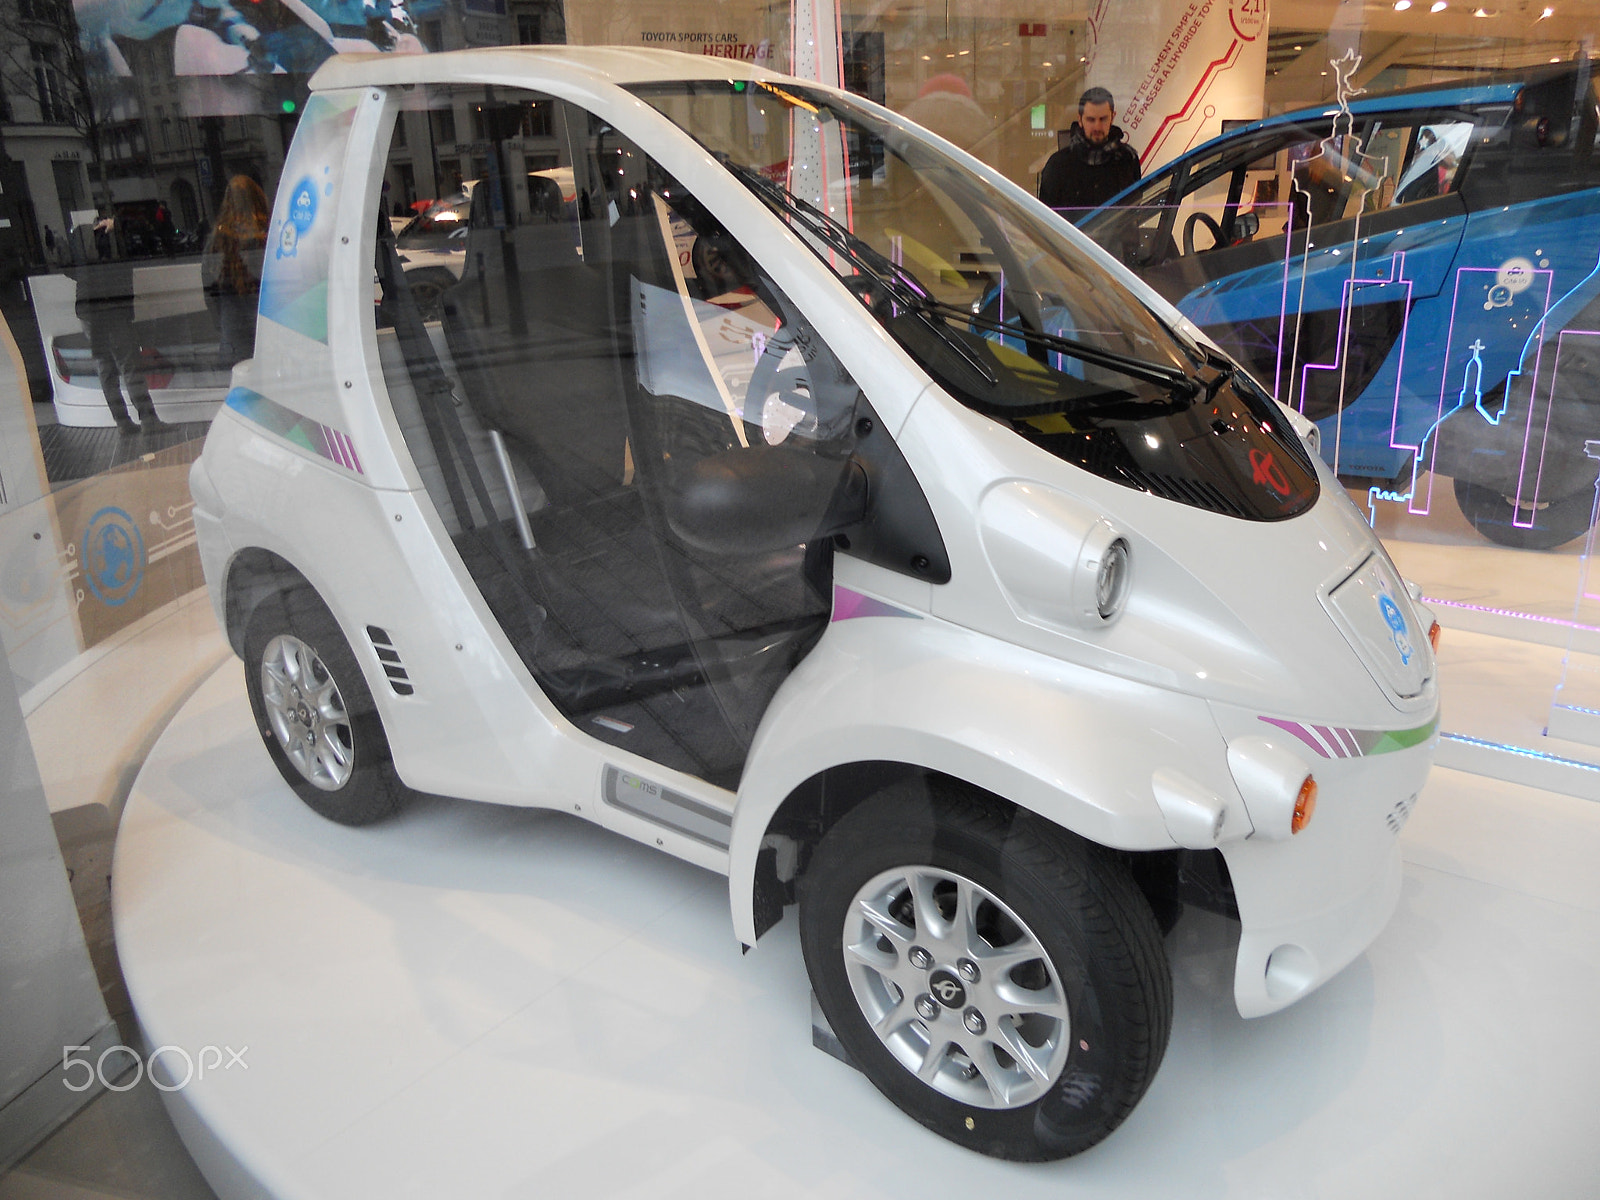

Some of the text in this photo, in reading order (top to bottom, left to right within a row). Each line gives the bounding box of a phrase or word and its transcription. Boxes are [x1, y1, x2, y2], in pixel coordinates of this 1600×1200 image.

[641, 31, 738, 43] TOYOTA SPORTS CARS
[703, 43, 775, 59] HERITAGE
[1122, 3, 1198, 123] C'EST TELLEMENT SIMPLE
[1130, 0, 1217, 130] DE PASSER A L'HYBRIDE TOY
